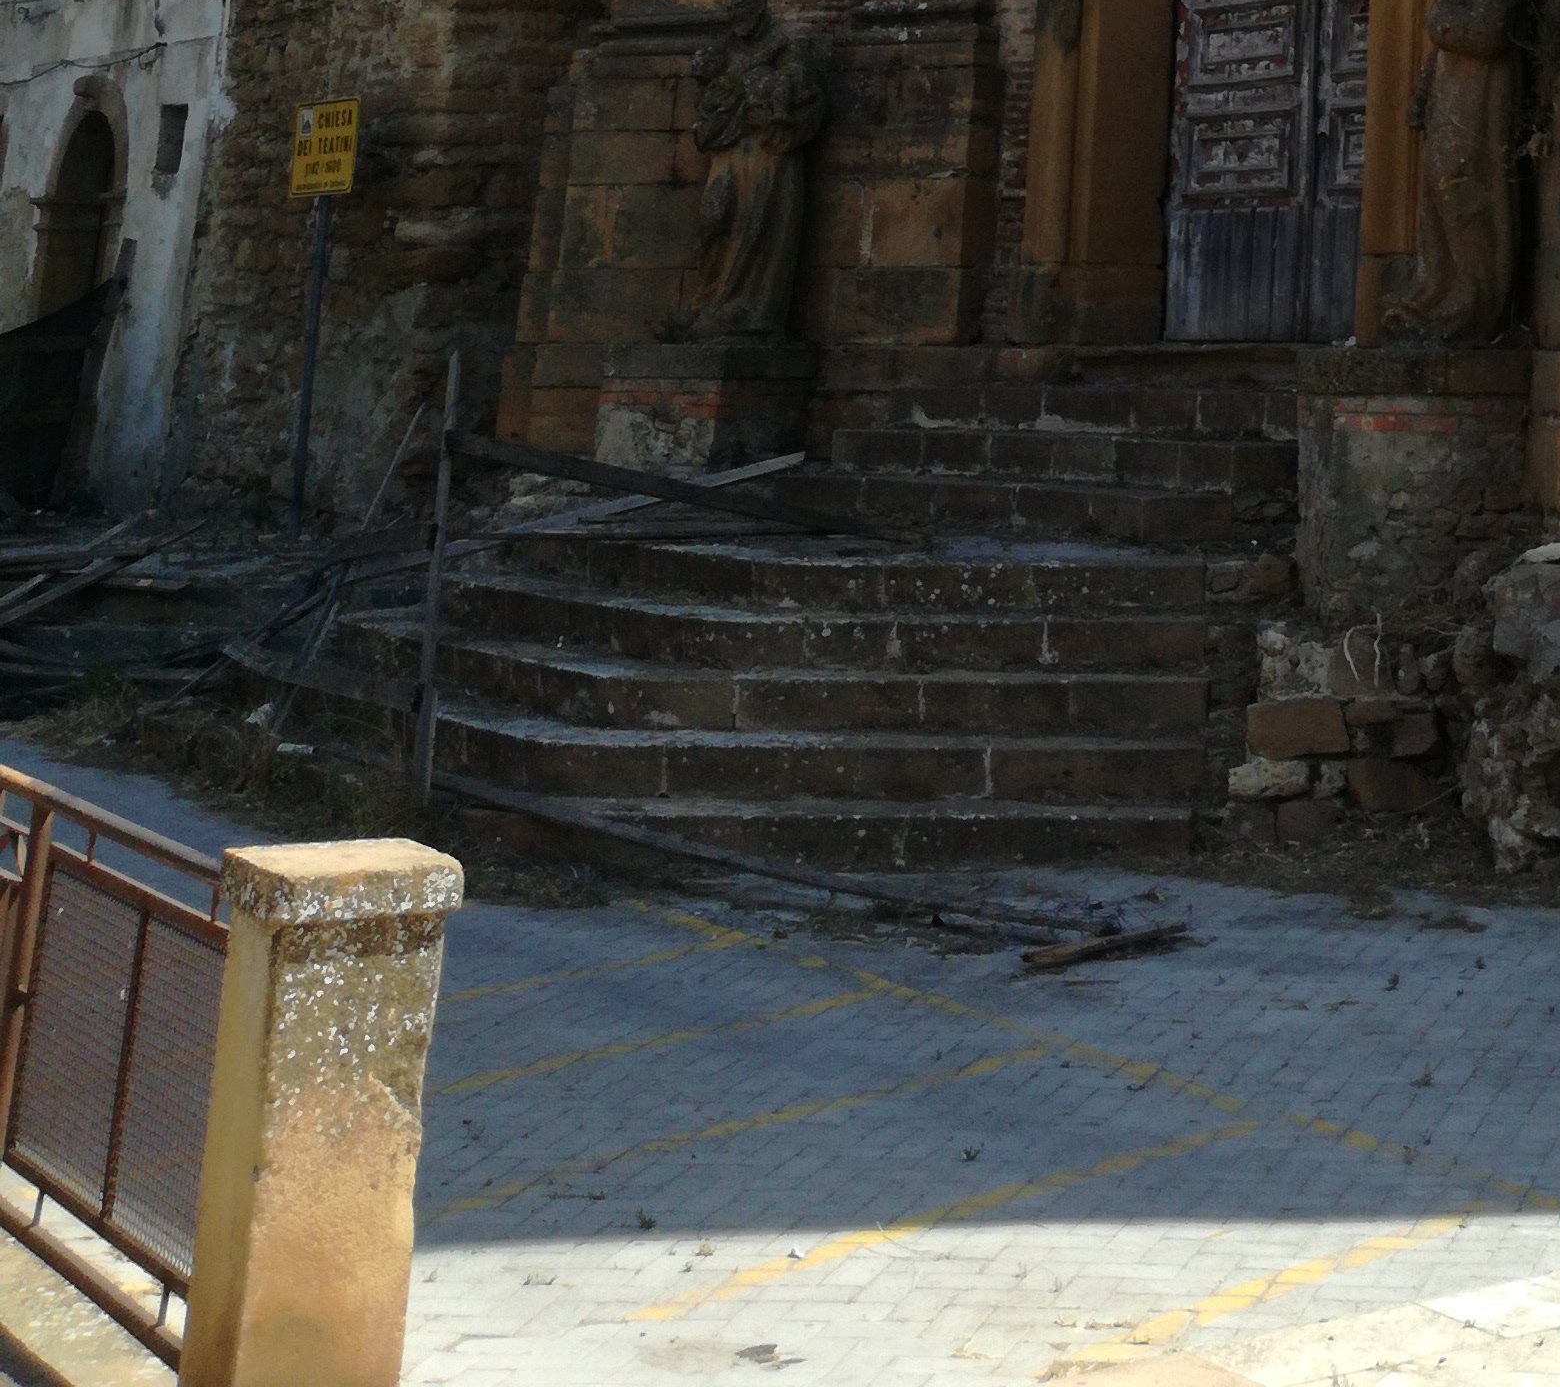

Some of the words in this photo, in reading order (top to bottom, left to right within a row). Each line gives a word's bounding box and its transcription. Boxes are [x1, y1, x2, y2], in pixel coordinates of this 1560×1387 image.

[317, 109, 353, 129] CHIESA
[297, 138, 313, 156] DEI
[318, 135, 353, 155] TEATINI
